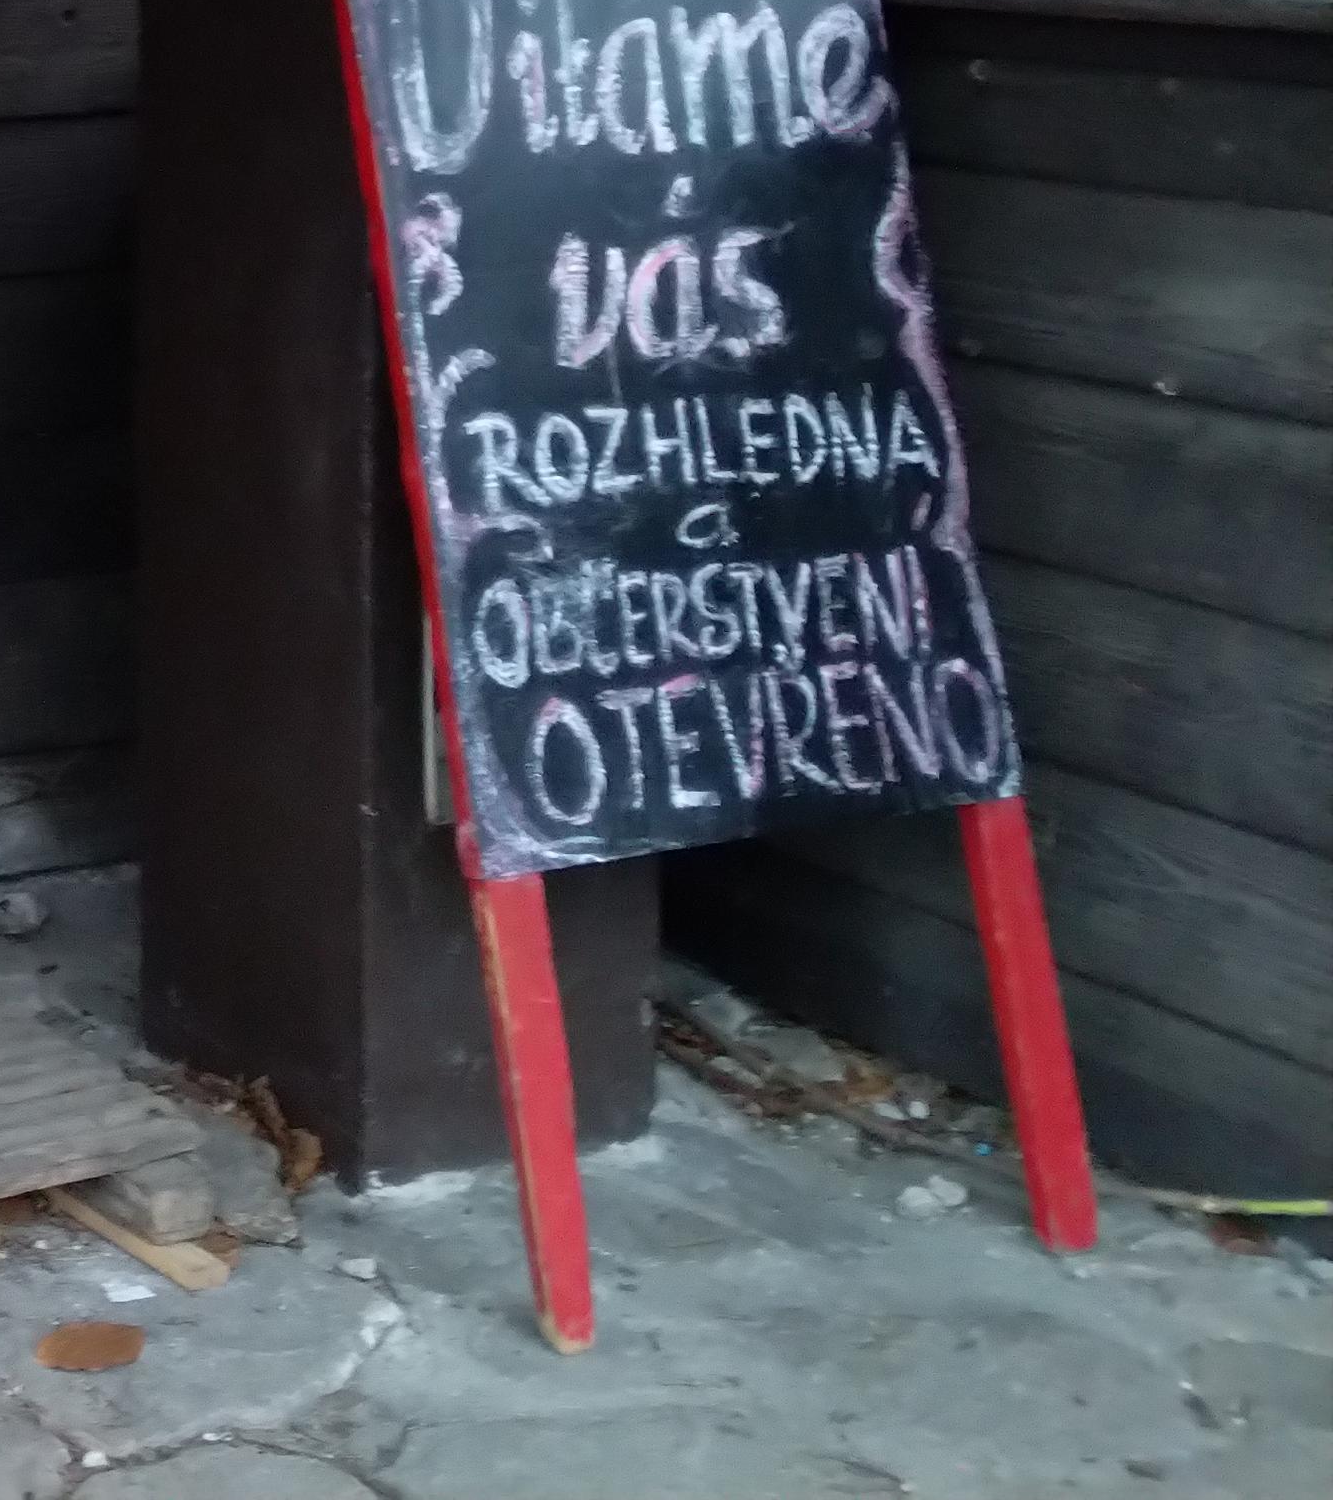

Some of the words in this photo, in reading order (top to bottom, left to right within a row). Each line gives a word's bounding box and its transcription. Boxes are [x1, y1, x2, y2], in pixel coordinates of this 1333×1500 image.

[552, 176, 795, 368] vás
[465, 384, 939, 510] ROZHLEDNA
[675, 503, 740, 549] a
